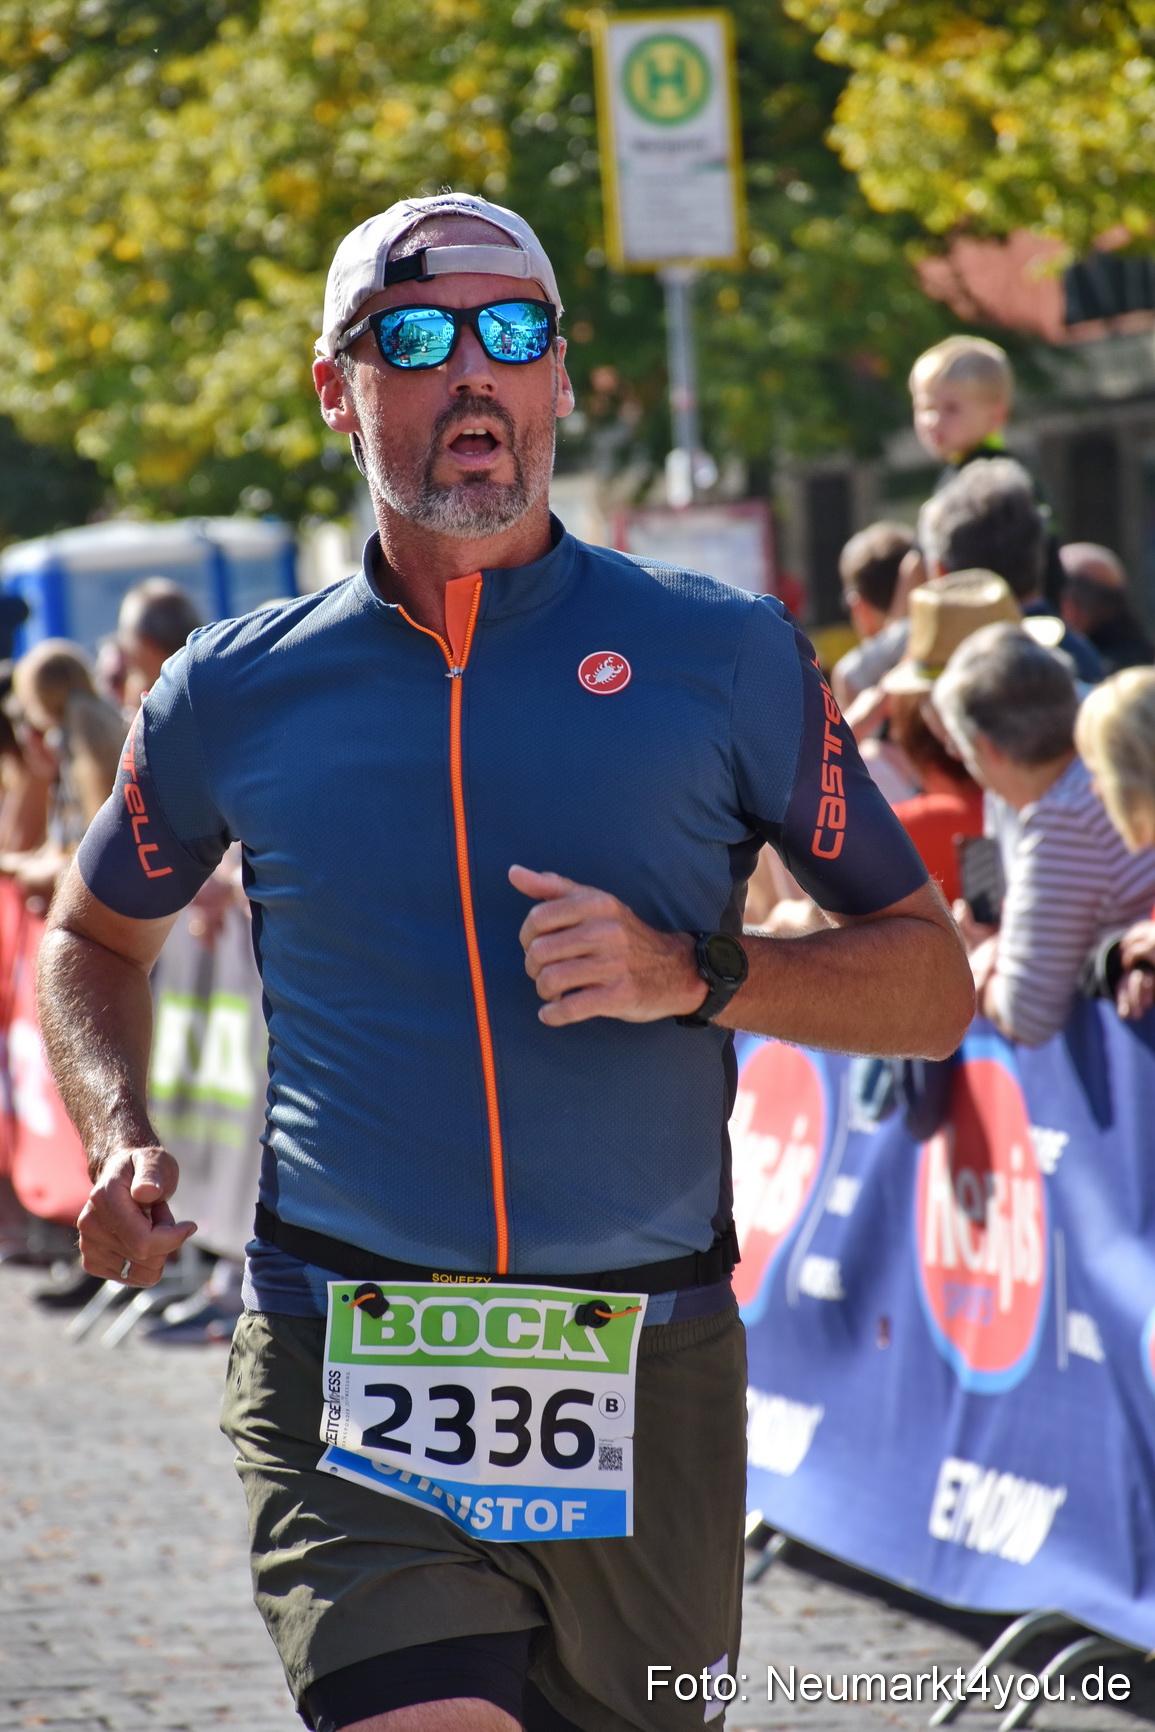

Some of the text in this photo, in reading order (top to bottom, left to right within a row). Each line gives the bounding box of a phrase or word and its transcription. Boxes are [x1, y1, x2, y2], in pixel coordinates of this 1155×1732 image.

[646, 57, 689, 102] H
[352, 1295, 615, 1363] BOCK
[361, 1383, 595, 1470] 2336
[605, 1398, 619, 1413] B
